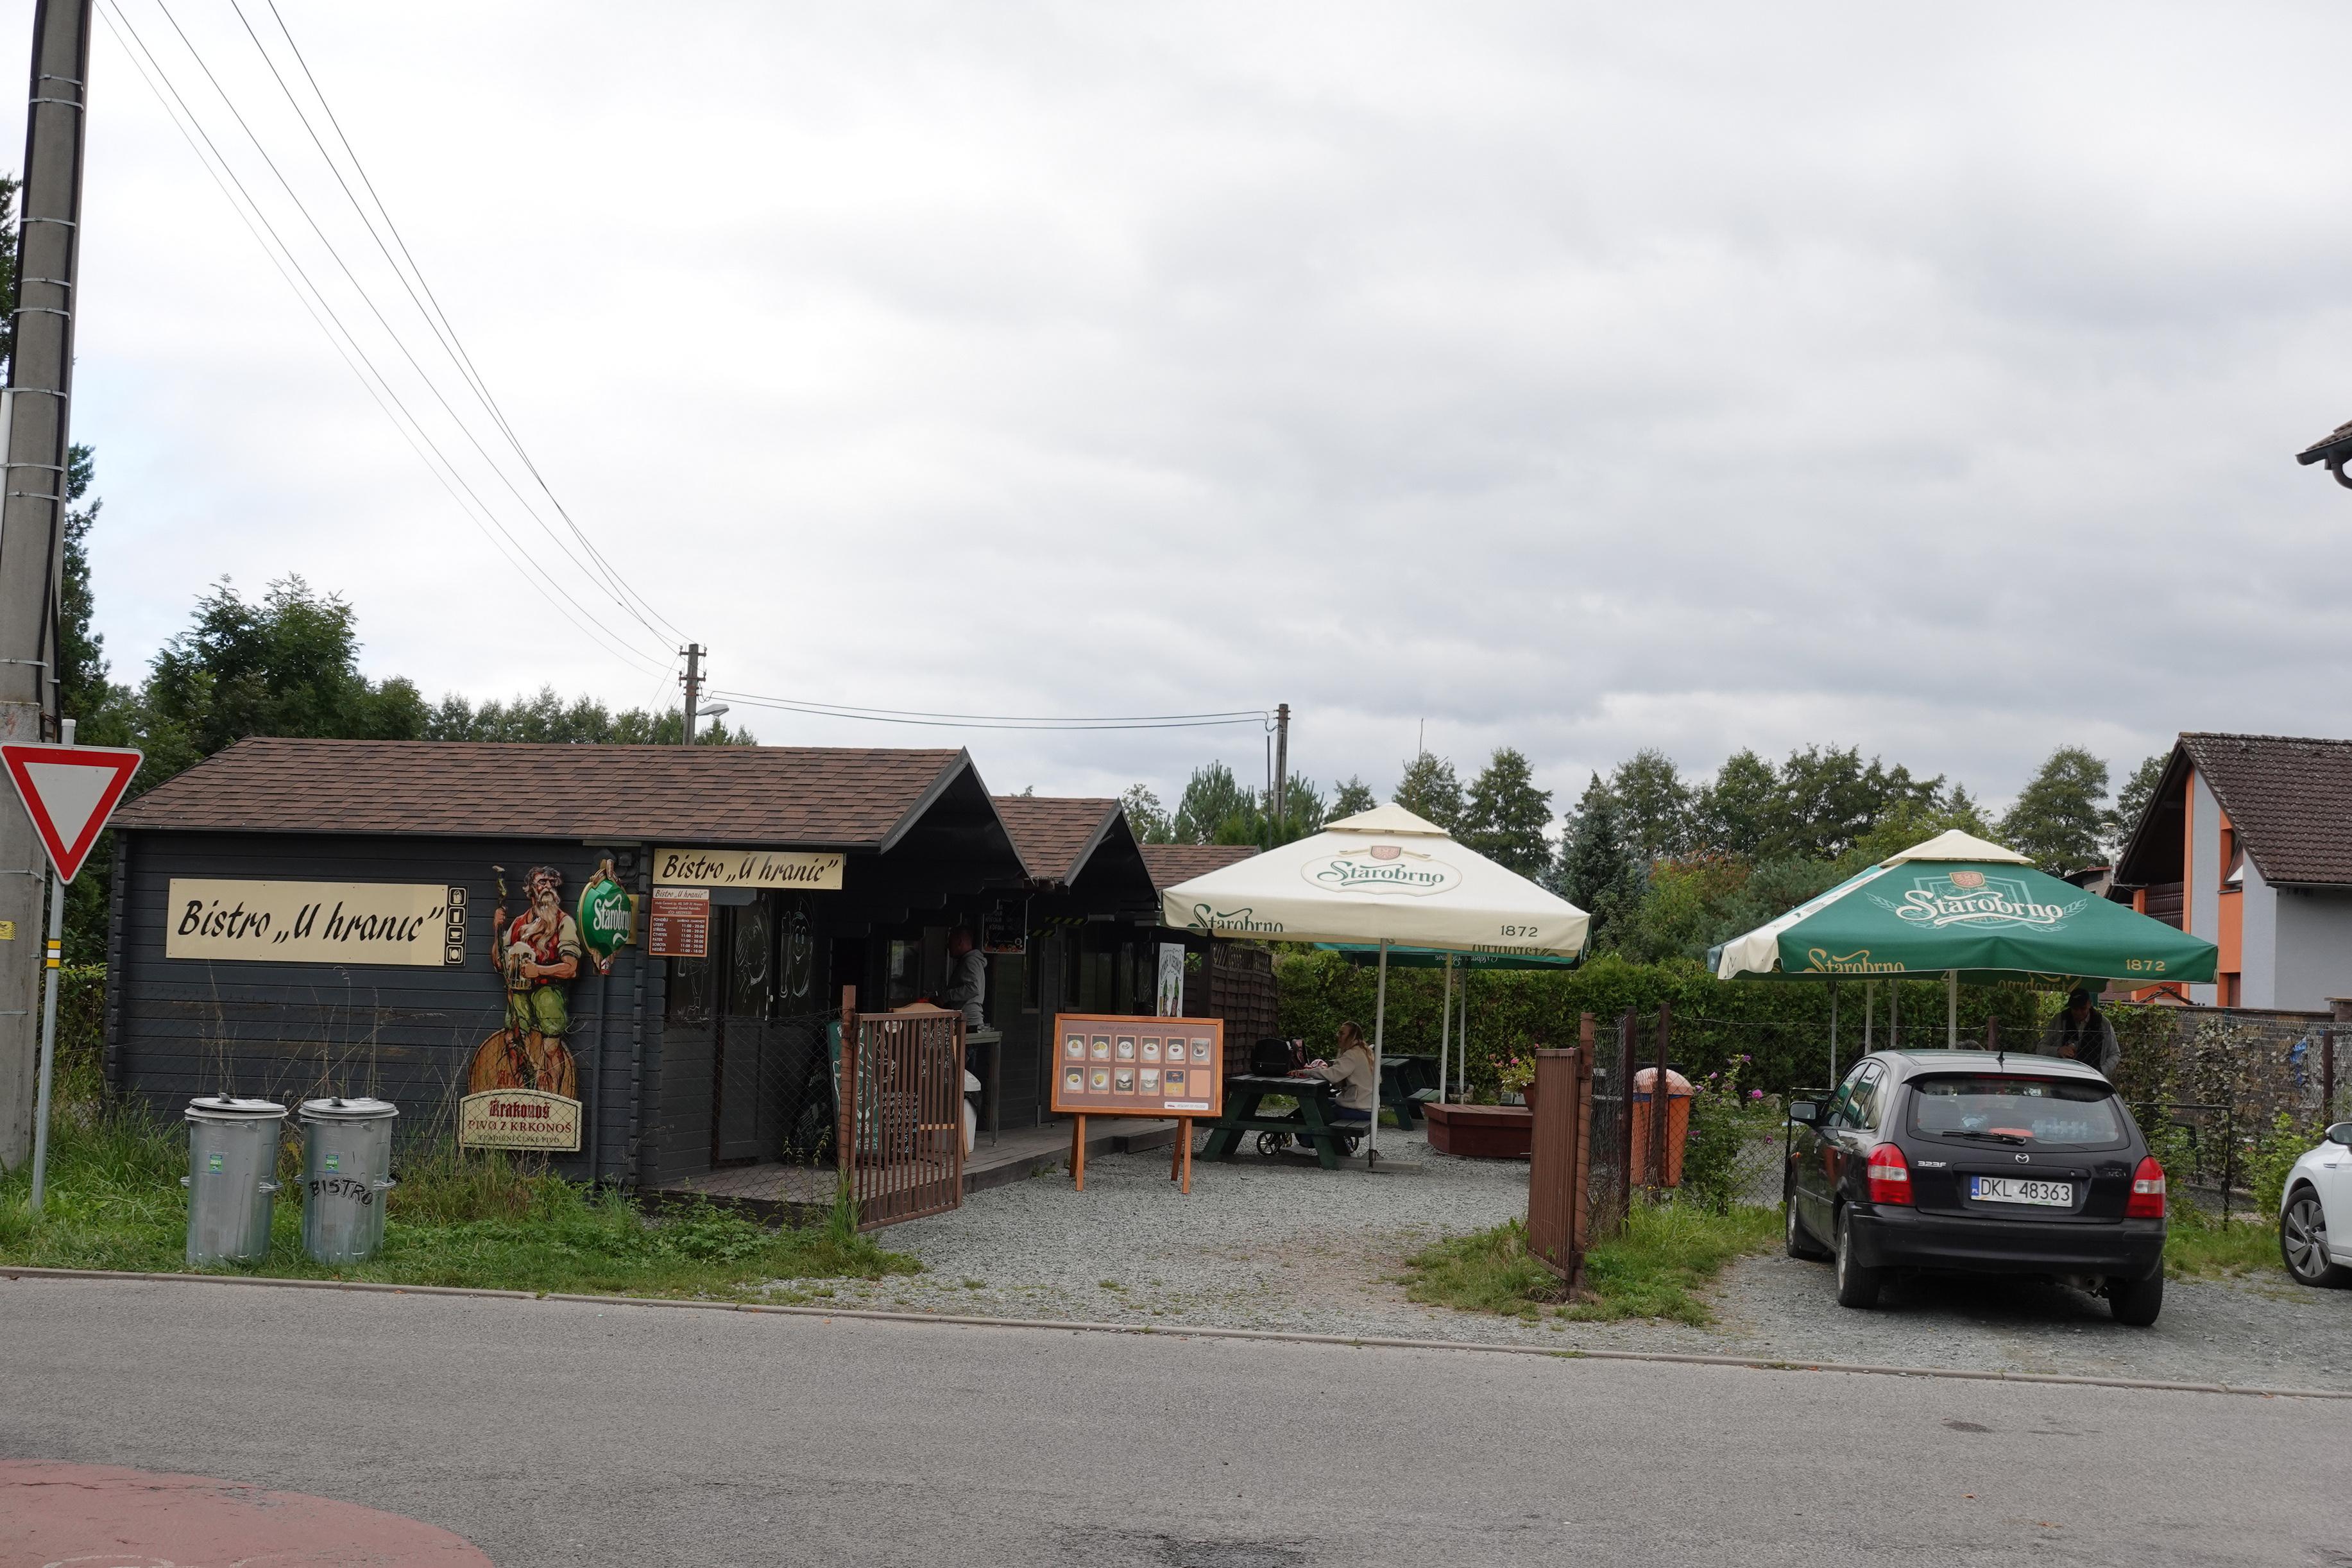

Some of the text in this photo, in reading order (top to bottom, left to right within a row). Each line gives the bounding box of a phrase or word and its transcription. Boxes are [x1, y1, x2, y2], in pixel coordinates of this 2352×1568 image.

[662, 854, 724, 880] Bistro
[1317, 860, 1444, 887] Starobrno
[178, 899, 271, 939] Bistro
[593, 894, 631, 932] Starobrno
[1187, 903, 1283, 932] Starobrno
[1896, 890, 2064, 926] Starobrno
[1501, 925, 1538, 937] 1872
[1803, 948, 1905, 973] Starobrno
[2125, 959, 2166, 971] 1872
[468, 1120, 572, 1133] PIVO Z KRKONOŠ
[309, 1178, 375, 1207] BISTRO
[1981, 1179, 2070, 1201] DKL 48363
